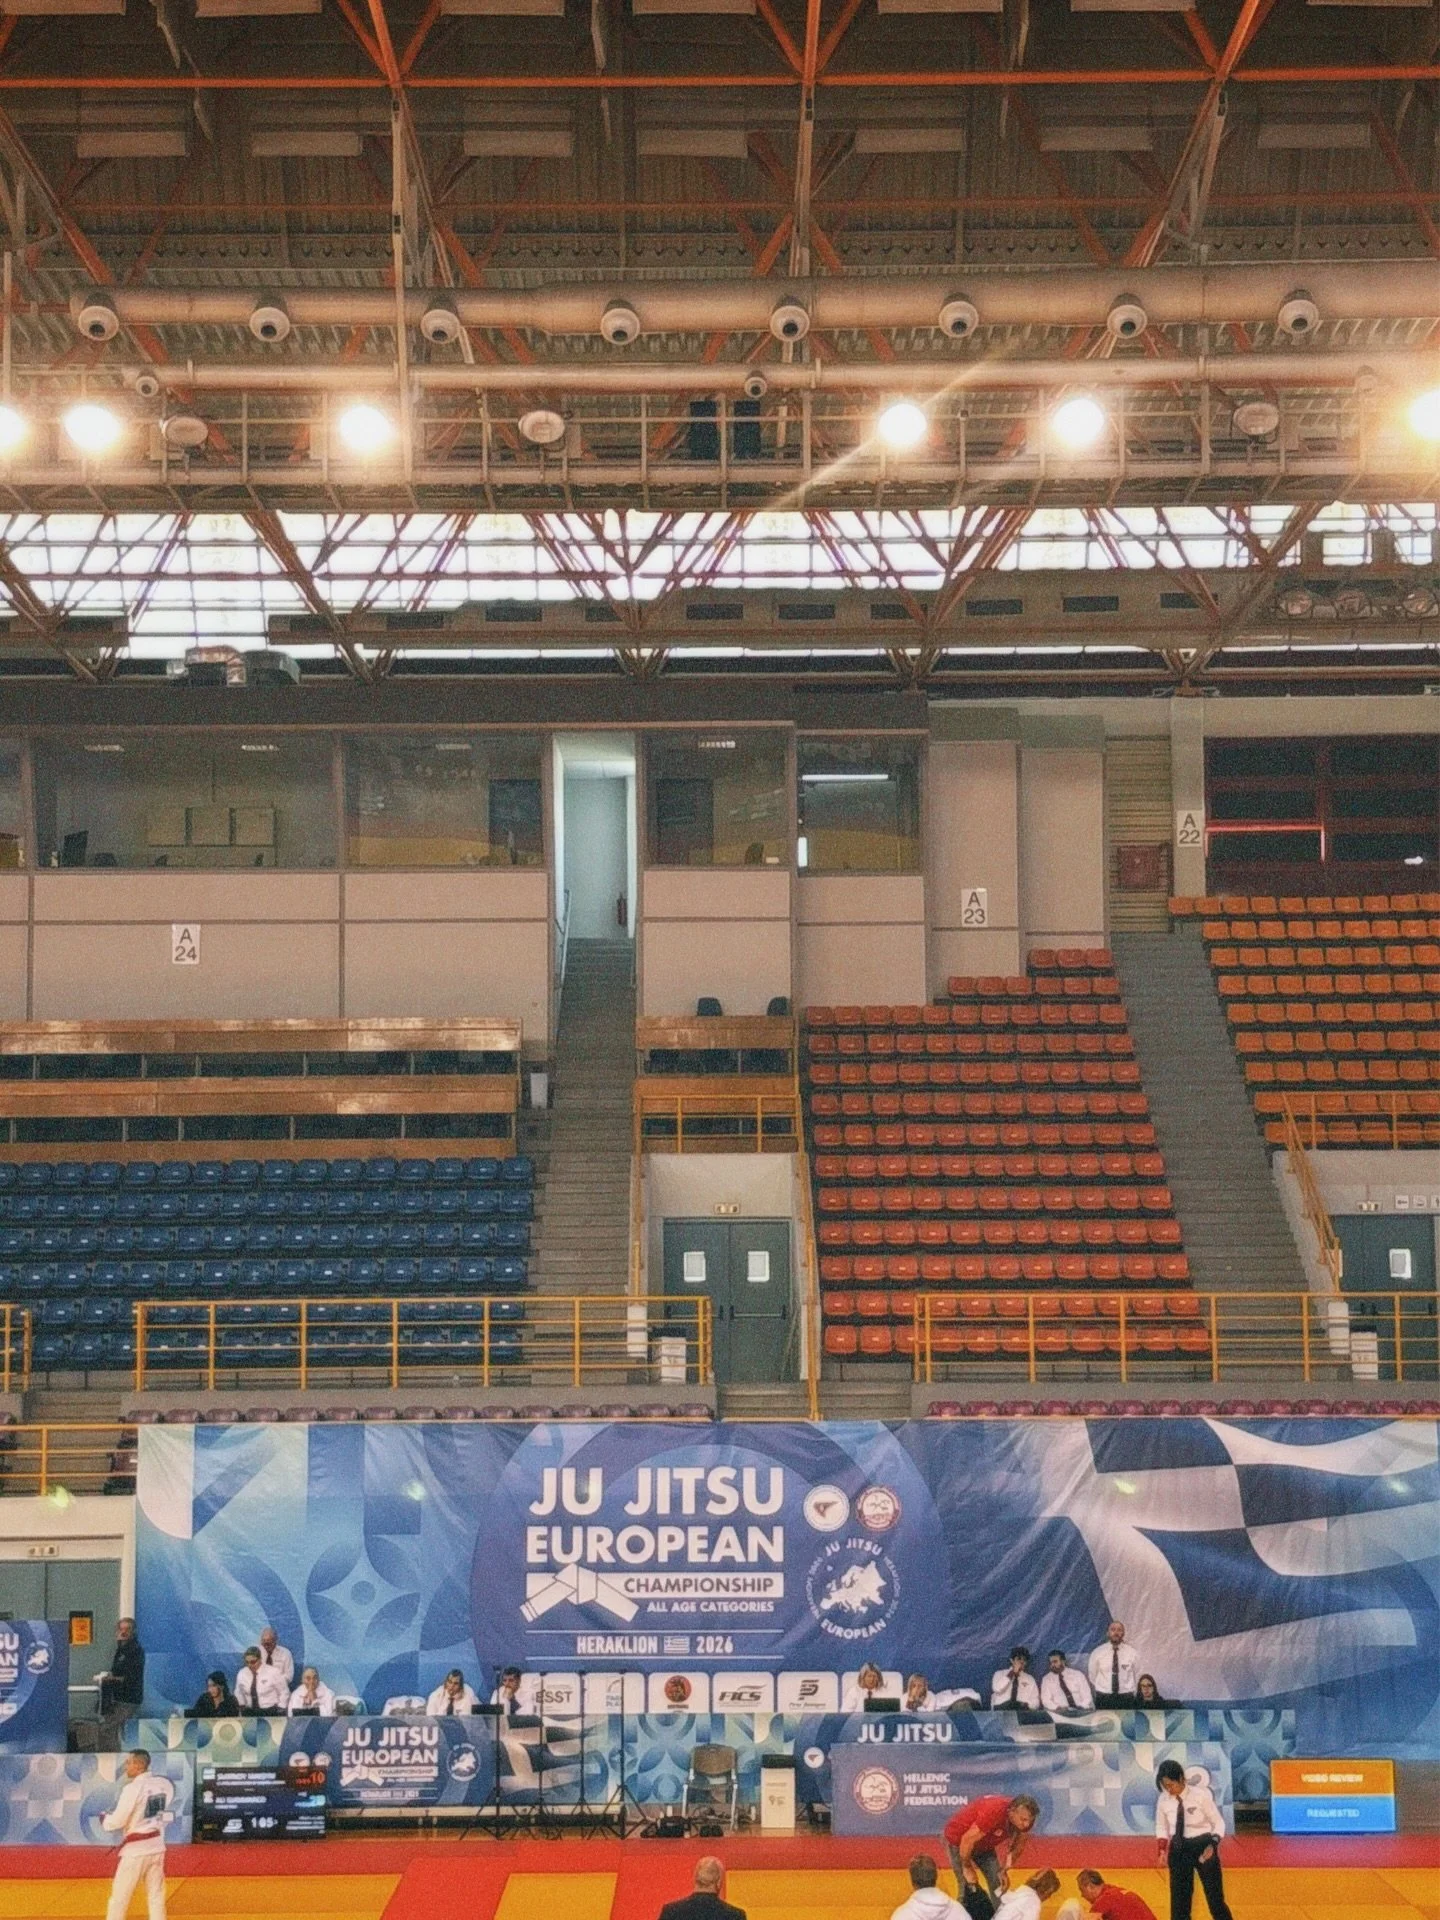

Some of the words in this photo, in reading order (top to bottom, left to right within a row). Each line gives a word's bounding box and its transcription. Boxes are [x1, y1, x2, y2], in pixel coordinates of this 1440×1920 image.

[1183, 813, 1196, 828] A
[1179, 829, 1200, 844] 22
[968, 891, 981, 907] A
[964, 908, 985, 924] 23
[179, 928, 193, 944] A
[174, 945, 197, 961] 24
[529, 1467, 603, 1516] JU
[623, 1466, 784, 1516] JITSU
[526, 1525, 784, 1564] EUROPEAN
[825, 1541, 841, 1557] JU
[846, 1537, 883, 1556] JITSU
[623, 1577, 774, 1594] CHAMPIONSHIP
[647, 1601, 668, 1613] ALL
[671, 1601, 696, 1613] AGE
[699, 1601, 775, 1613] CATEGORIES
[820, 1617, 887, 1640] EUROPEAN
[576, 1635, 659, 1654] HERAKLION
[342, 1727, 371, 1747] JU
[377, 1726, 438, 1747] JITSU
[857, 1724, 885, 1743] JU
[892, 1723, 952, 1743] JITSU
[342, 1749, 438, 1765] EUROPEAN
[903, 1773, 951, 1783] HELLENIC
[904, 1785, 918, 1795] JU
[920, 1785, 948, 1795] JITSU
[904, 1795, 969, 1806] FEDERATION
